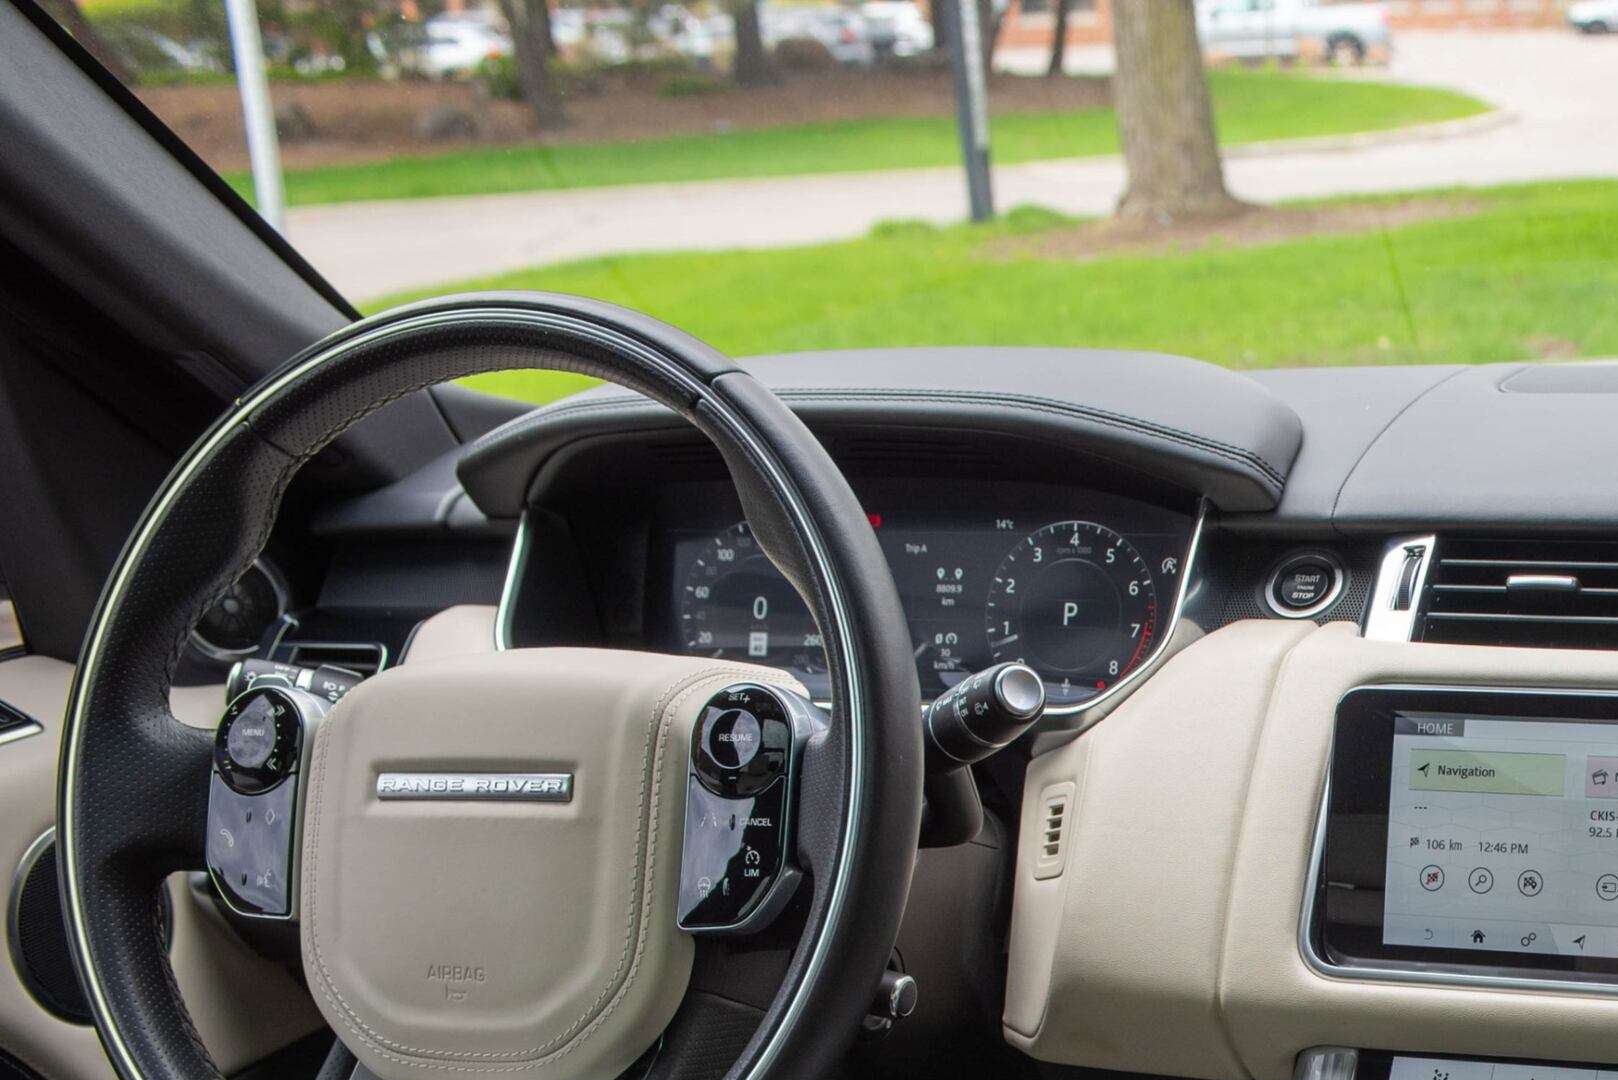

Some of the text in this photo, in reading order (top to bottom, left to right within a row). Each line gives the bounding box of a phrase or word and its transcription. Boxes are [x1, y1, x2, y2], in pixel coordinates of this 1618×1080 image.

[1069, 533, 1079, 545] 4
[717, 548, 735, 561] 100
[1033, 548, 1042, 562] 3
[1105, 548, 1115, 563] 5
[1294, 574, 1320, 584] START
[695, 586, 710, 599] 60
[1005, 579, 1015, 593] 2
[1128, 581, 1139, 596] 6
[753, 596, 768, 620] 0
[941, 597, 955, 606] km
[1063, 602, 1078, 626] P
[1003, 621, 1010, 635] 1
[1130, 623, 1141, 638] 7
[933, 660, 956, 670] km/h
[1109, 660, 1118, 675] 8
[241, 728, 265, 737] MENU
[1417, 723, 1454, 735] HOME
[718, 733, 753, 742] RESUME
[1437, 765, 1496, 779] Navigation
[380, 779, 564, 793] RANGE ROVER
[738, 818, 772, 827] CANCEL
[1588, 826, 1612, 839] 92.5
[1426, 839, 1463, 851] 106 km
[1478, 842, 1529, 854] 12:46 PM
[744, 868, 760, 877] LIM
[426, 965, 487, 982] AIRBAG
